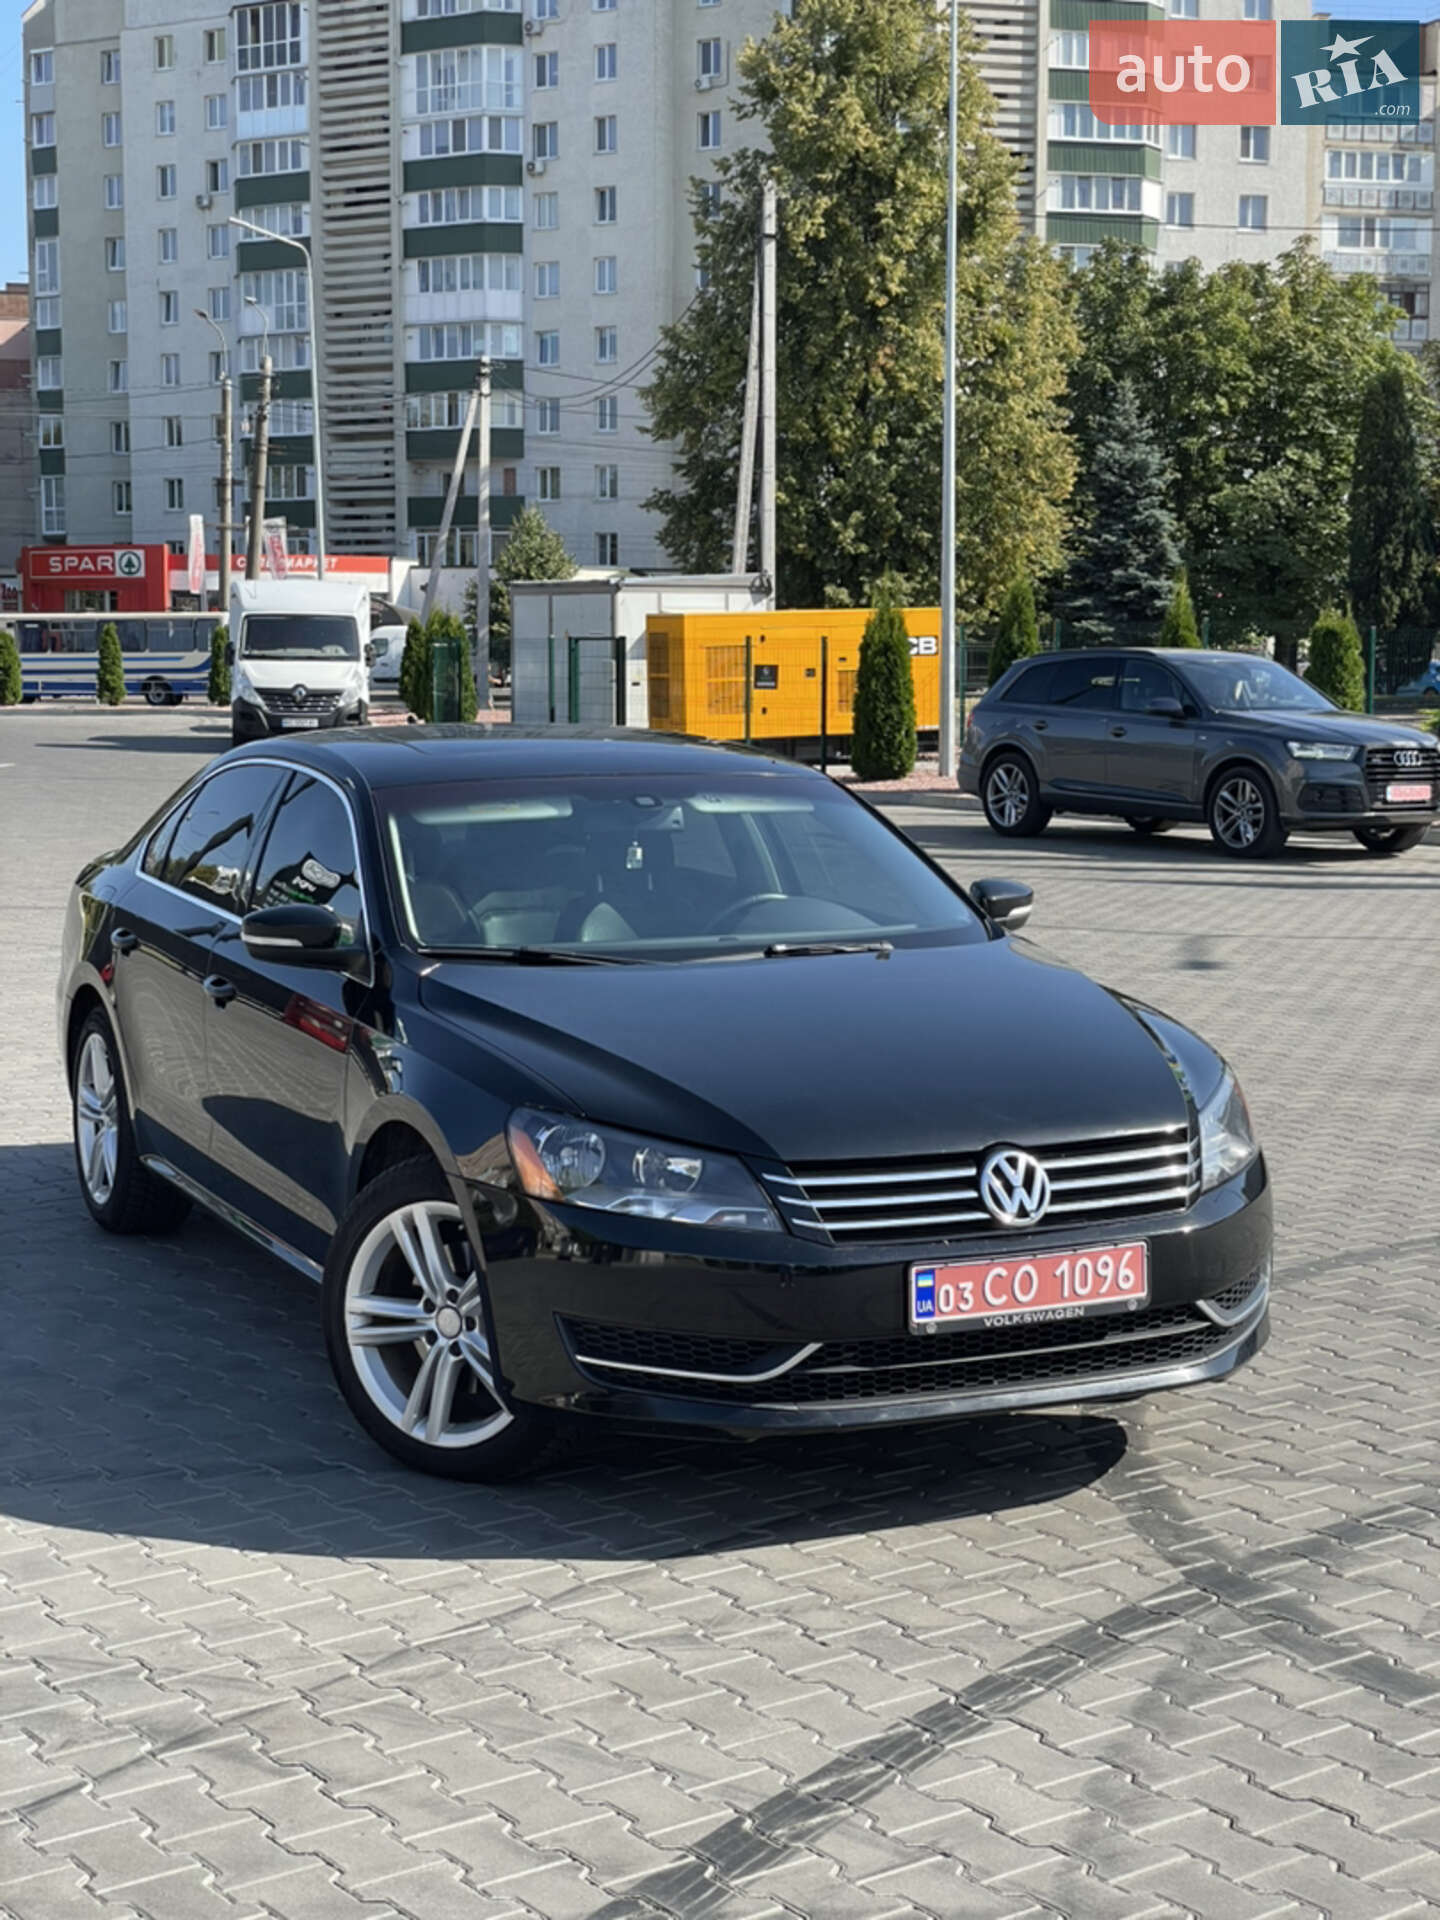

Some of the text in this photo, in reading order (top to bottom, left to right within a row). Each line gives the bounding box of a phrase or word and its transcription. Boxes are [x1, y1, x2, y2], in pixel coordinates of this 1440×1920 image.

[49, 556, 113, 573] SPAR
[938, 1250, 1135, 1313] 03 CO 1096
[917, 1299, 934, 1313] UA
[983, 1306, 1085, 1327] VOLKSWAGEN
